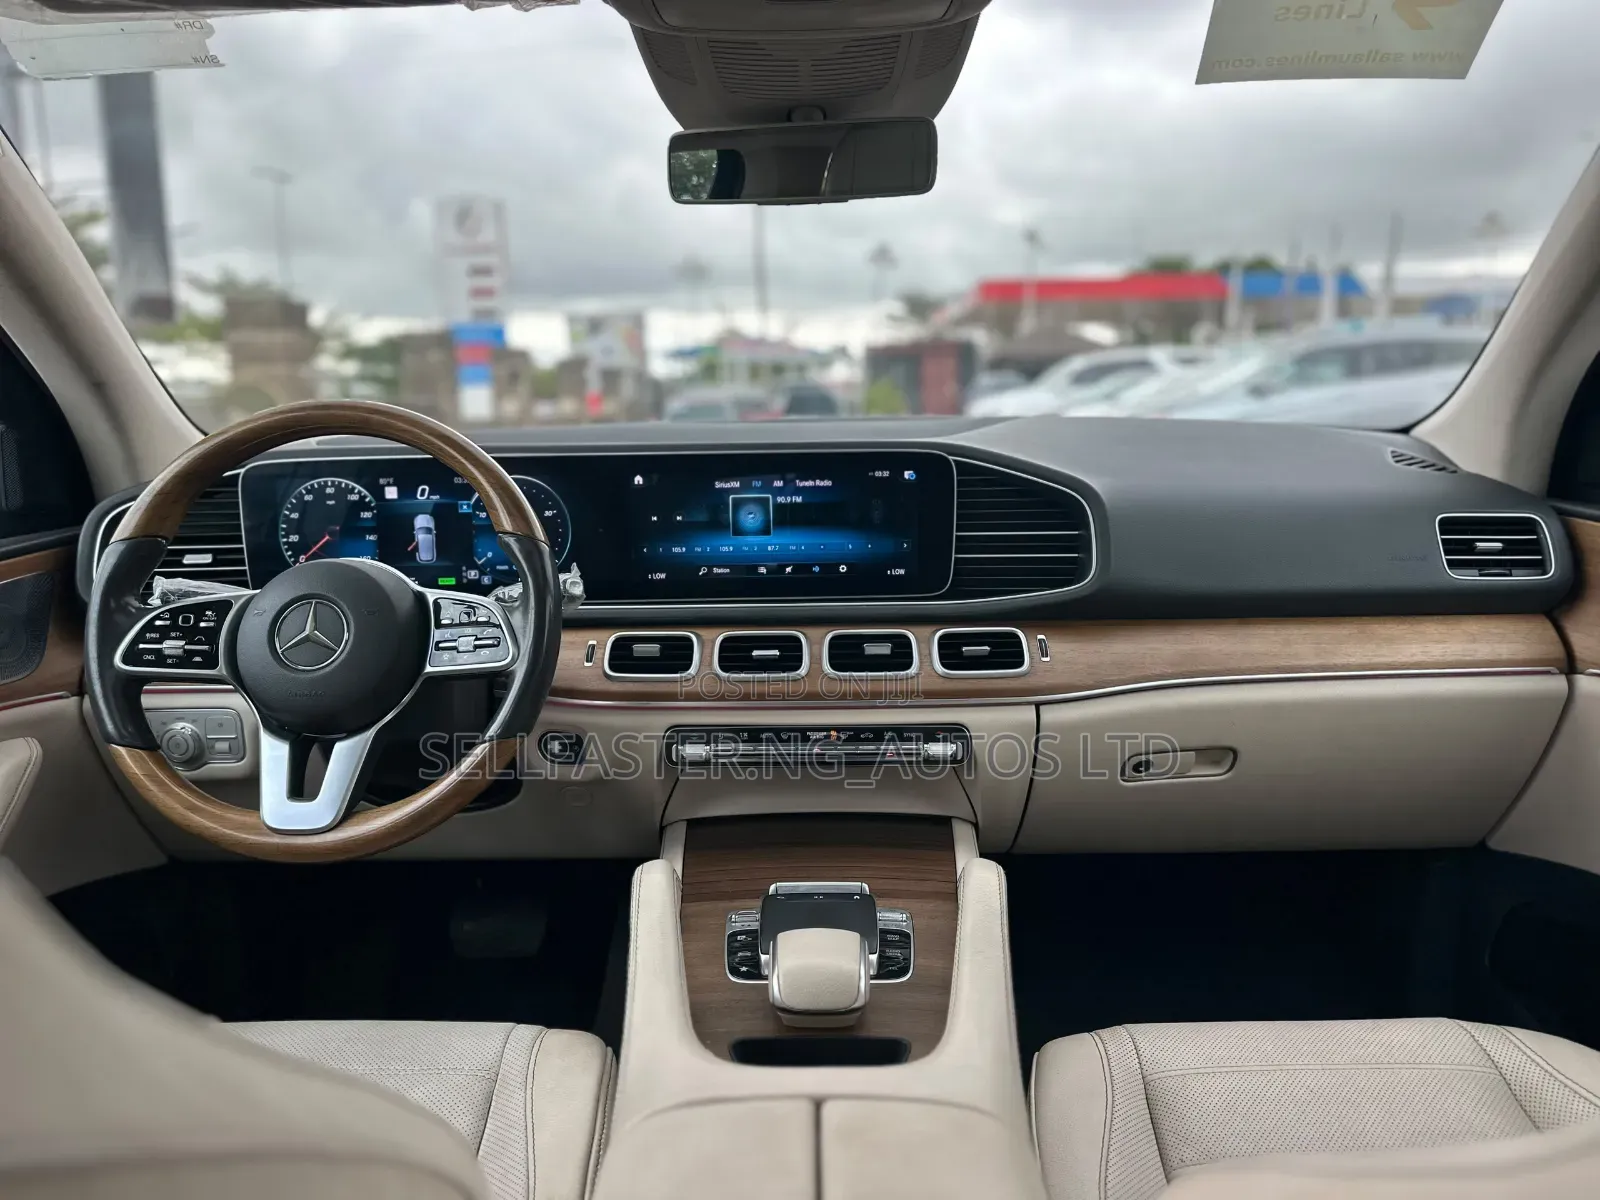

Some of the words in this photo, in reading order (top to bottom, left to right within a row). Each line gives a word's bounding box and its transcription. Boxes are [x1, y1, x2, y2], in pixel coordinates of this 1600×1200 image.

[714, 481, 740, 489] SiriusXM
[751, 480, 762, 488] FM
[773, 480, 784, 488] AM
[795, 479, 815, 487] TuneIn
[815, 479, 833, 487] Radio
[416, 485, 430, 500] 0
[776, 496, 791, 504] 90.9
[792, 496, 803, 504] FM
[652, 572, 667, 580] LOW
